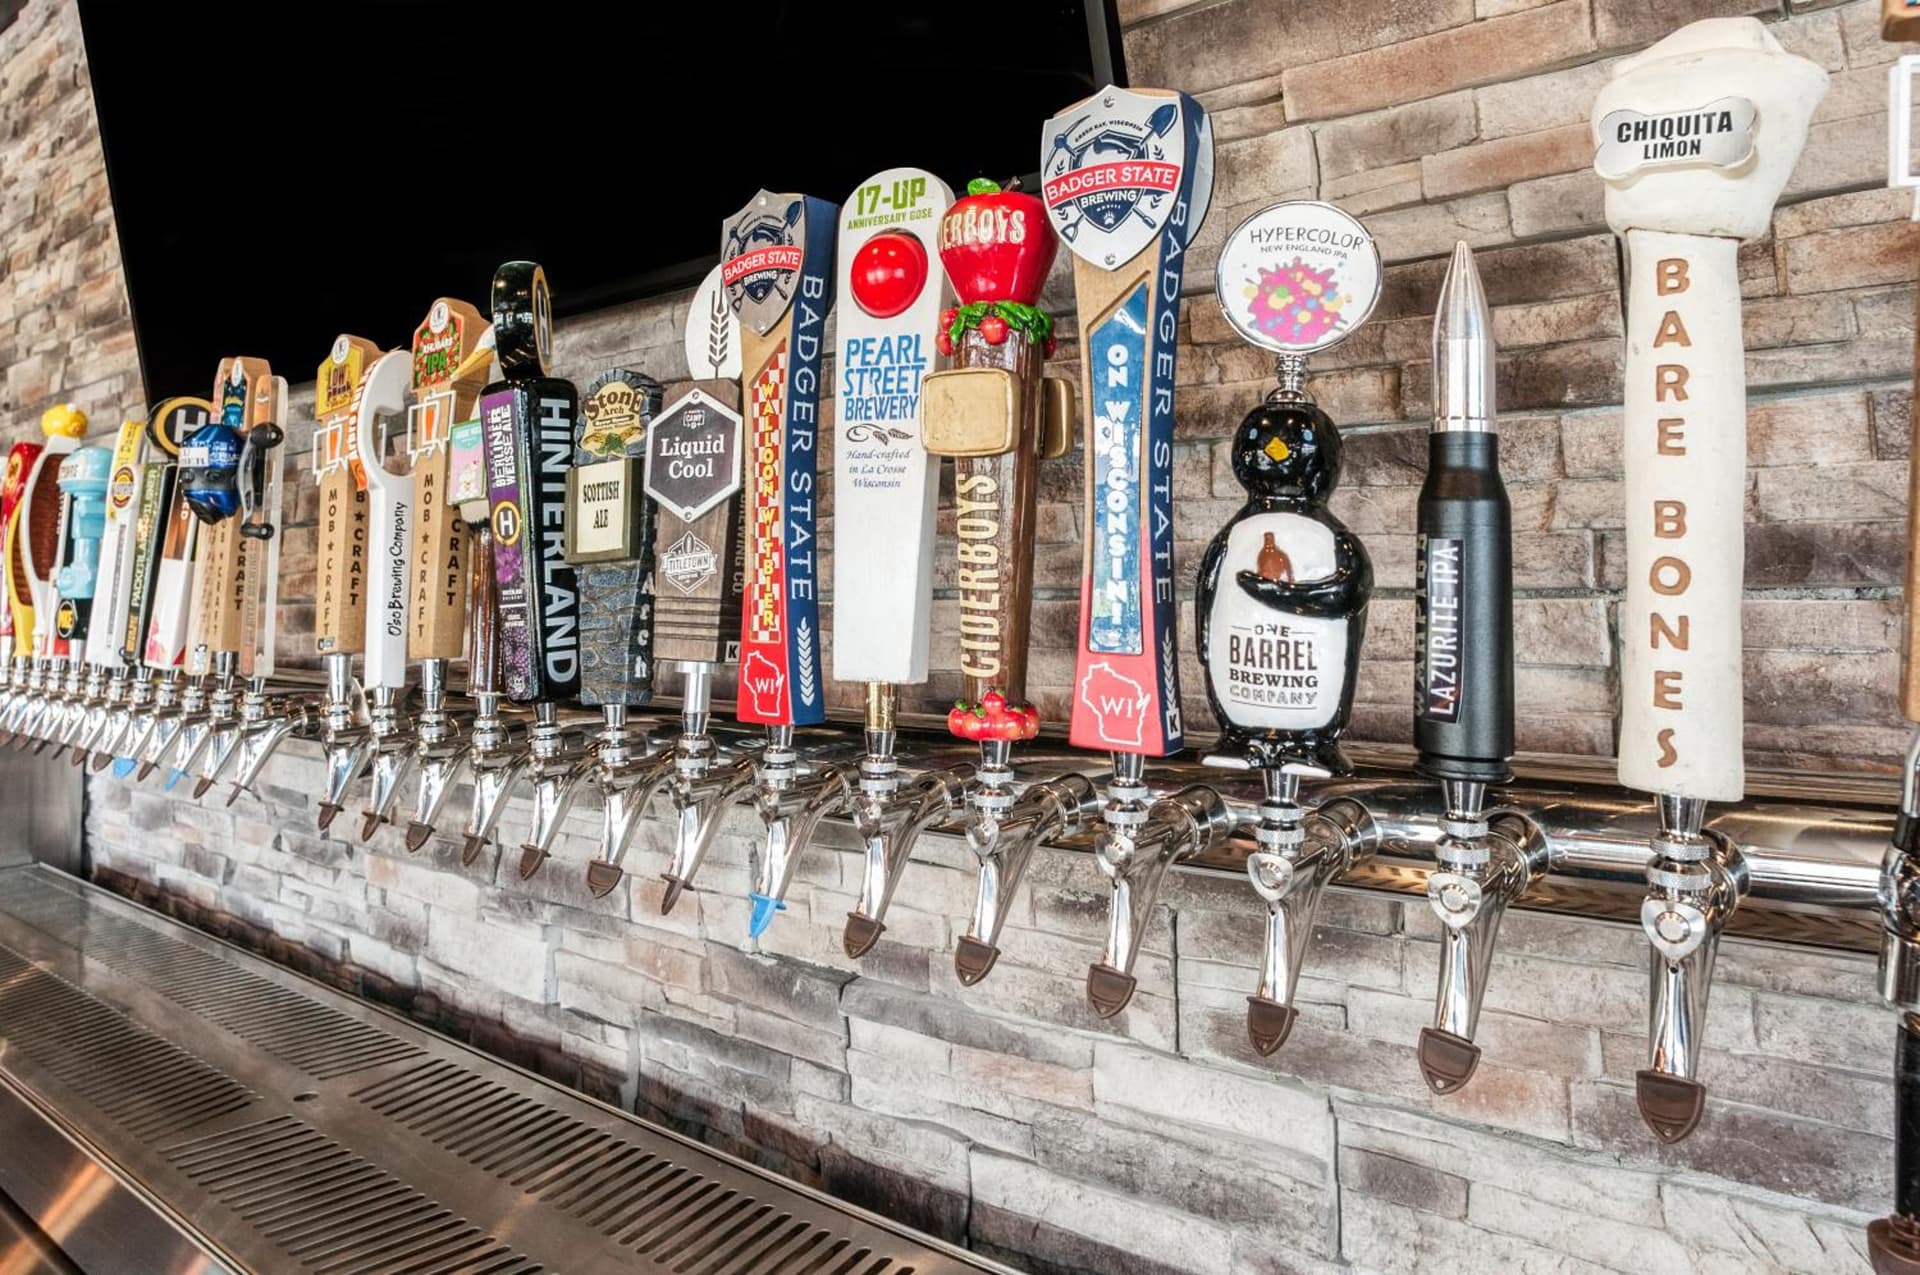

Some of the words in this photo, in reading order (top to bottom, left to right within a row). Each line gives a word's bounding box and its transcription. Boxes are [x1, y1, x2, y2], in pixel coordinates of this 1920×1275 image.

[1617, 111, 1733, 143] CHIQUITA
[1643, 139, 1702, 160] LIMON
[857, 177, 927, 216] 17-UP
[1046, 168, 1117, 201] BADGER
[1120, 166, 1176, 186] STATE
[1080, 190, 1138, 208] BREWING
[847, 210, 907, 230] ANNIVERSARY
[909, 207, 933, 221] GOSE
[1250, 227, 1364, 251] HYPERCOLOR
[1260, 245, 1283, 254] NEW
[1286, 243, 1332, 256] ENGLAND
[1333, 251, 1348, 260] IPA
[724, 254, 766, 280] BADGER
[767, 250, 800, 265] STATE
[743, 271, 778, 286] BREWING
[1154, 200, 1188, 417] BADGER
[791, 275, 825, 453] BADGER
[845, 333, 927, 367] PEARL
[1106, 344, 1128, 388] ON
[1652, 257, 1692, 457] BARE
[843, 364, 926, 396] STREET
[501, 404, 514, 431] ALE
[604, 407, 624, 416] Arch
[844, 394, 919, 422] BREWERY
[174, 408, 208, 443] H
[760, 382, 778, 498] WALLOON
[491, 405, 506, 488] BERLINER
[502, 433, 517, 486] WEISSE
[659, 434, 725, 459] Liquid
[846, 448, 912, 462] Hand-crafted
[668, 458, 715, 479] Cool
[848, 465, 859, 474] in
[861, 464, 875, 474] La
[876, 464, 907, 474] Crosse
[852, 477, 902, 489] Wisconsin
[423, 474, 434, 523] MOB
[583, 480, 620, 503] SCOTTISH
[328, 488, 338, 532] MOB
[499, 510, 515, 536] H
[593, 509, 609, 528] ALE
[1152, 440, 1174, 605] STATE
[388, 501, 408, 557] Company
[540, 398, 577, 683] HINTERLAND
[789, 469, 813, 602] STATE
[234, 540, 247, 611] CRAFT
[350, 528, 364, 606] CRAFT
[446, 519, 461, 606] CRAFT
[760, 507, 780, 628] WITBIER
[955, 473, 1000, 678] CIDERBOYS
[1431, 545, 1460, 585] IPA
[323, 557, 333, 636] CRAFT
[387, 558, 406, 610] Brewing
[417, 551, 428, 638] CRAFT
[387, 610, 402, 637] O'so
[1254, 624, 1292, 637] ONE
[1649, 499, 1692, 769] BONES
[1229, 634, 1318, 671] BARREL
[1429, 596, 1459, 716] LAZURITE
[755, 677, 776, 695] WI
[1229, 668, 1319, 688] BREWING
[1229, 685, 1318, 704] COMPANY
[1101, 695, 1134, 719] WI
[1169, 714, 1179, 734] K
